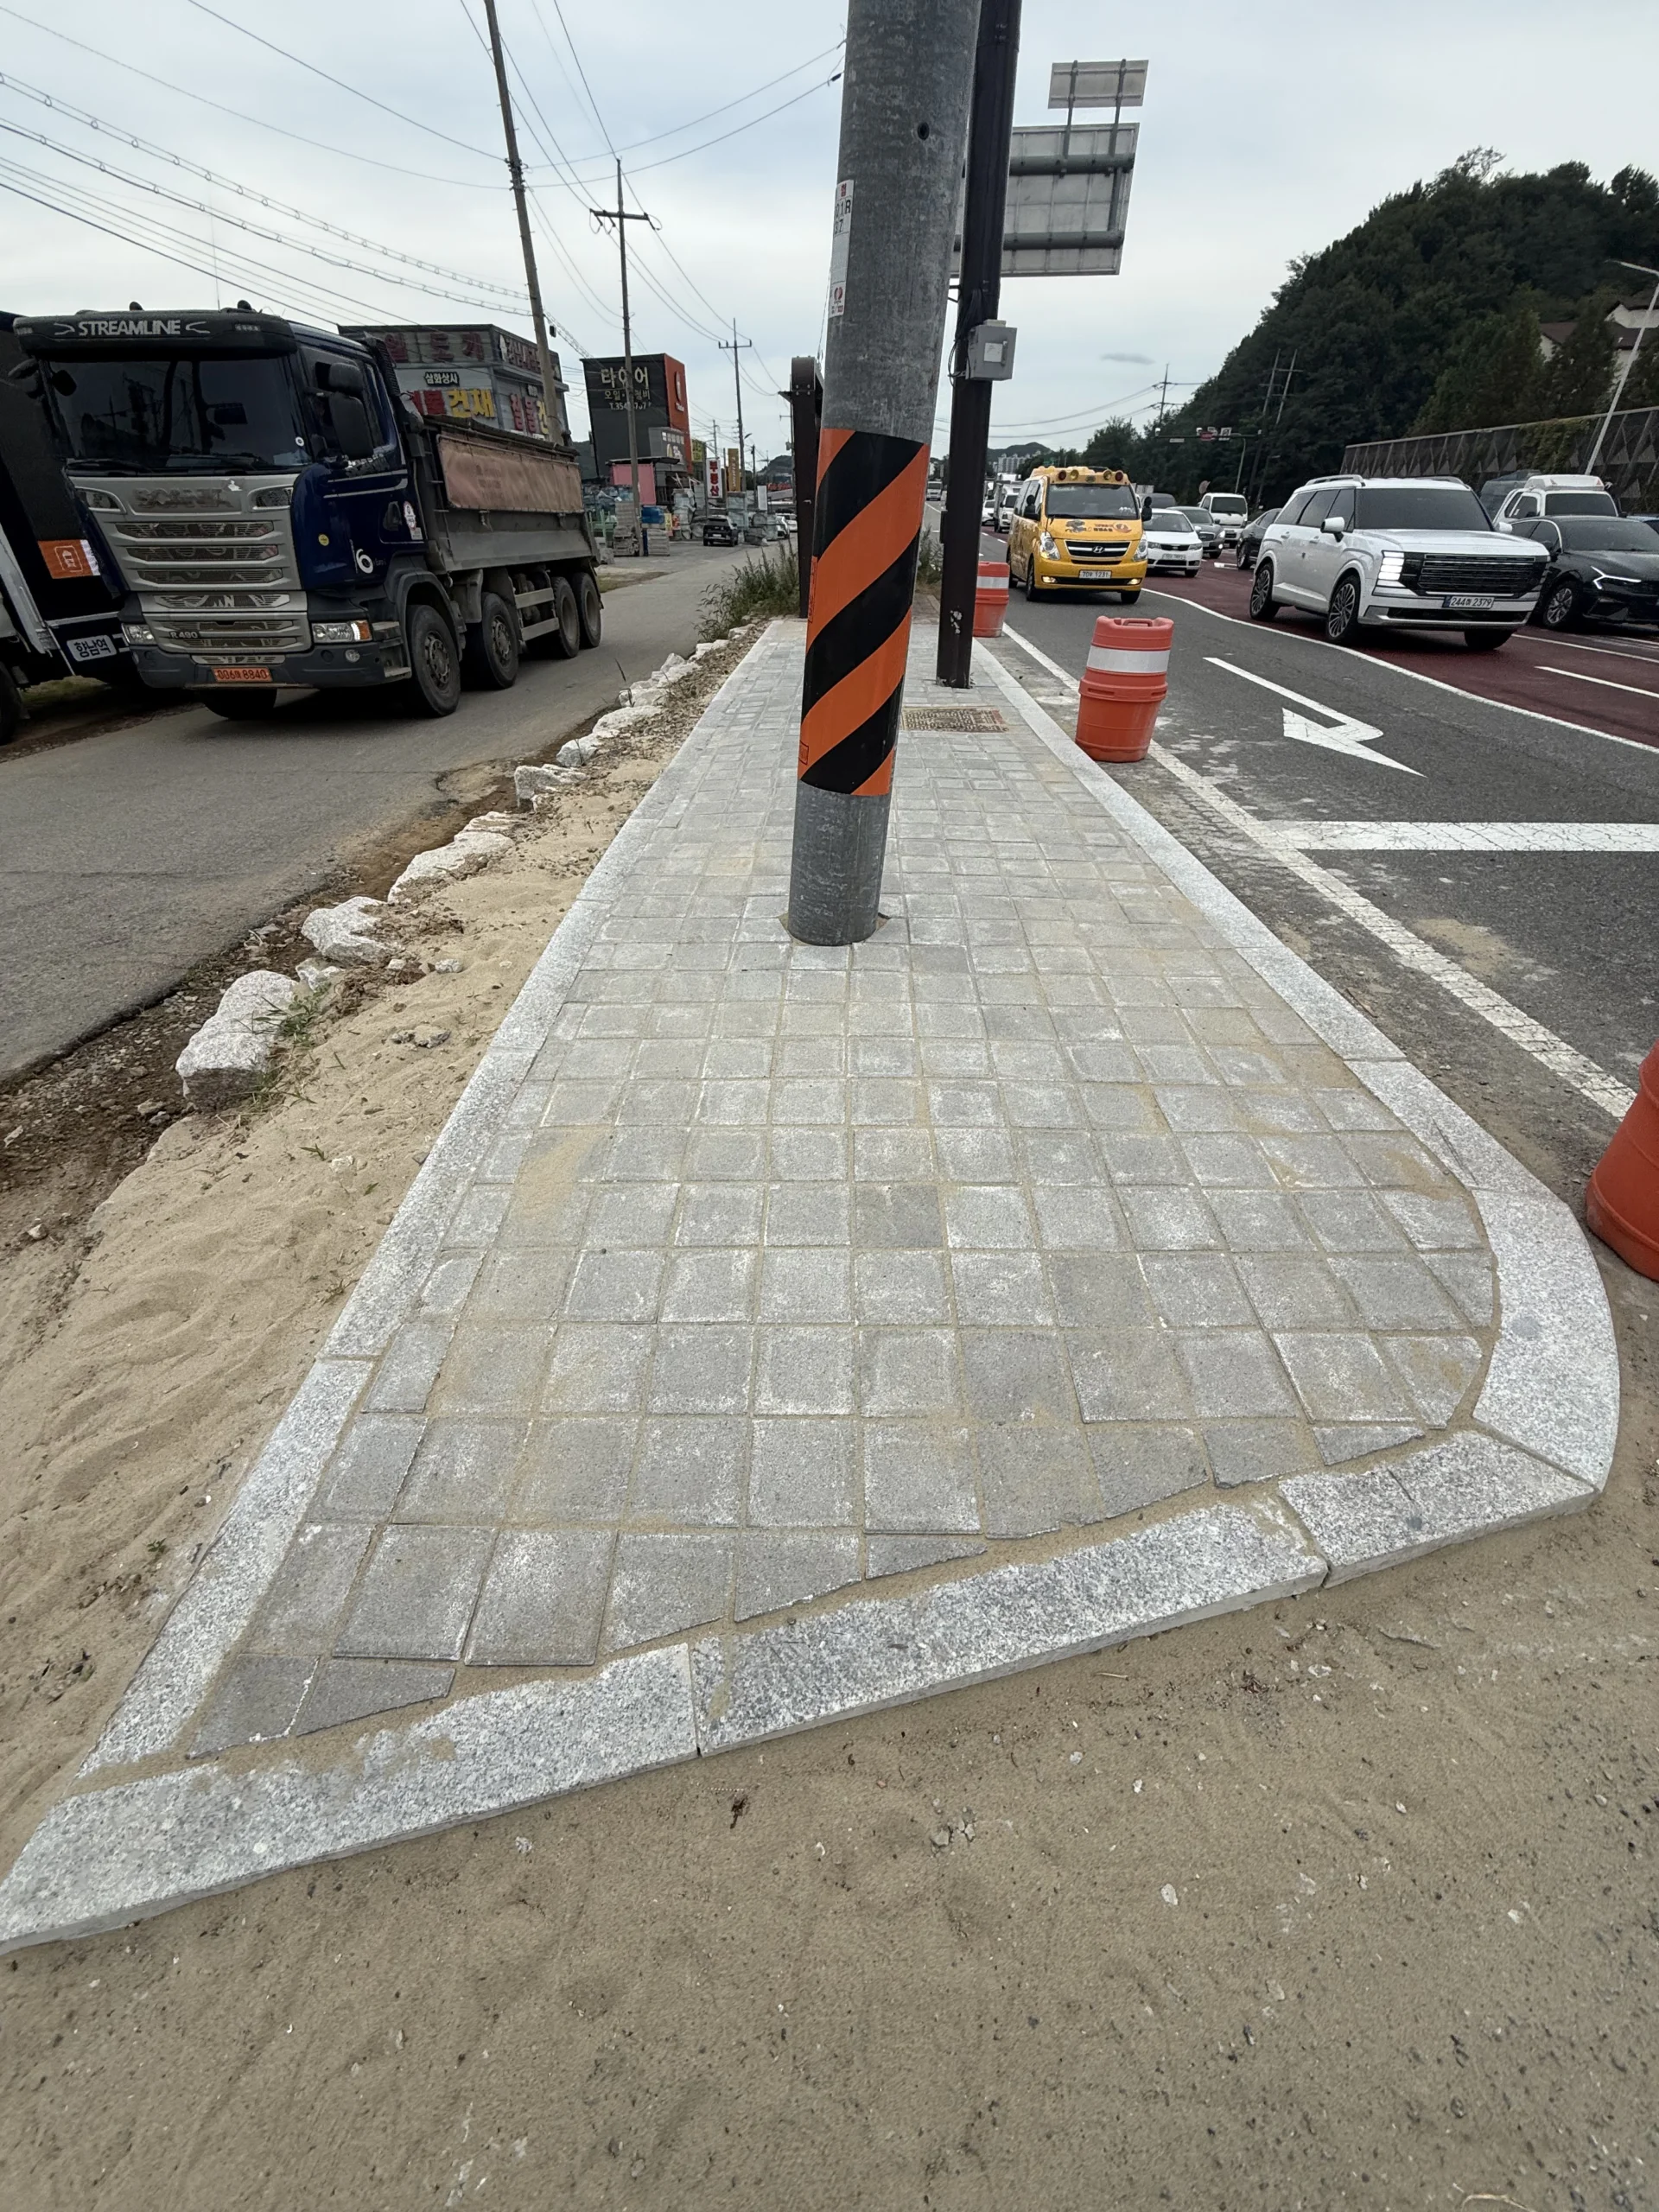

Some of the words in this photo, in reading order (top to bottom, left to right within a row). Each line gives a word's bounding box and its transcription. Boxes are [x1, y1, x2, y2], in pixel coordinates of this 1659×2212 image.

[78, 320, 181, 336] STREAMLINE
[709, 460, 720, 497] 부동산
[1471, 597, 1492, 607] 2379
[73, 638, 111, 658] 향남역
[242, 669, 268, 680] 8840
